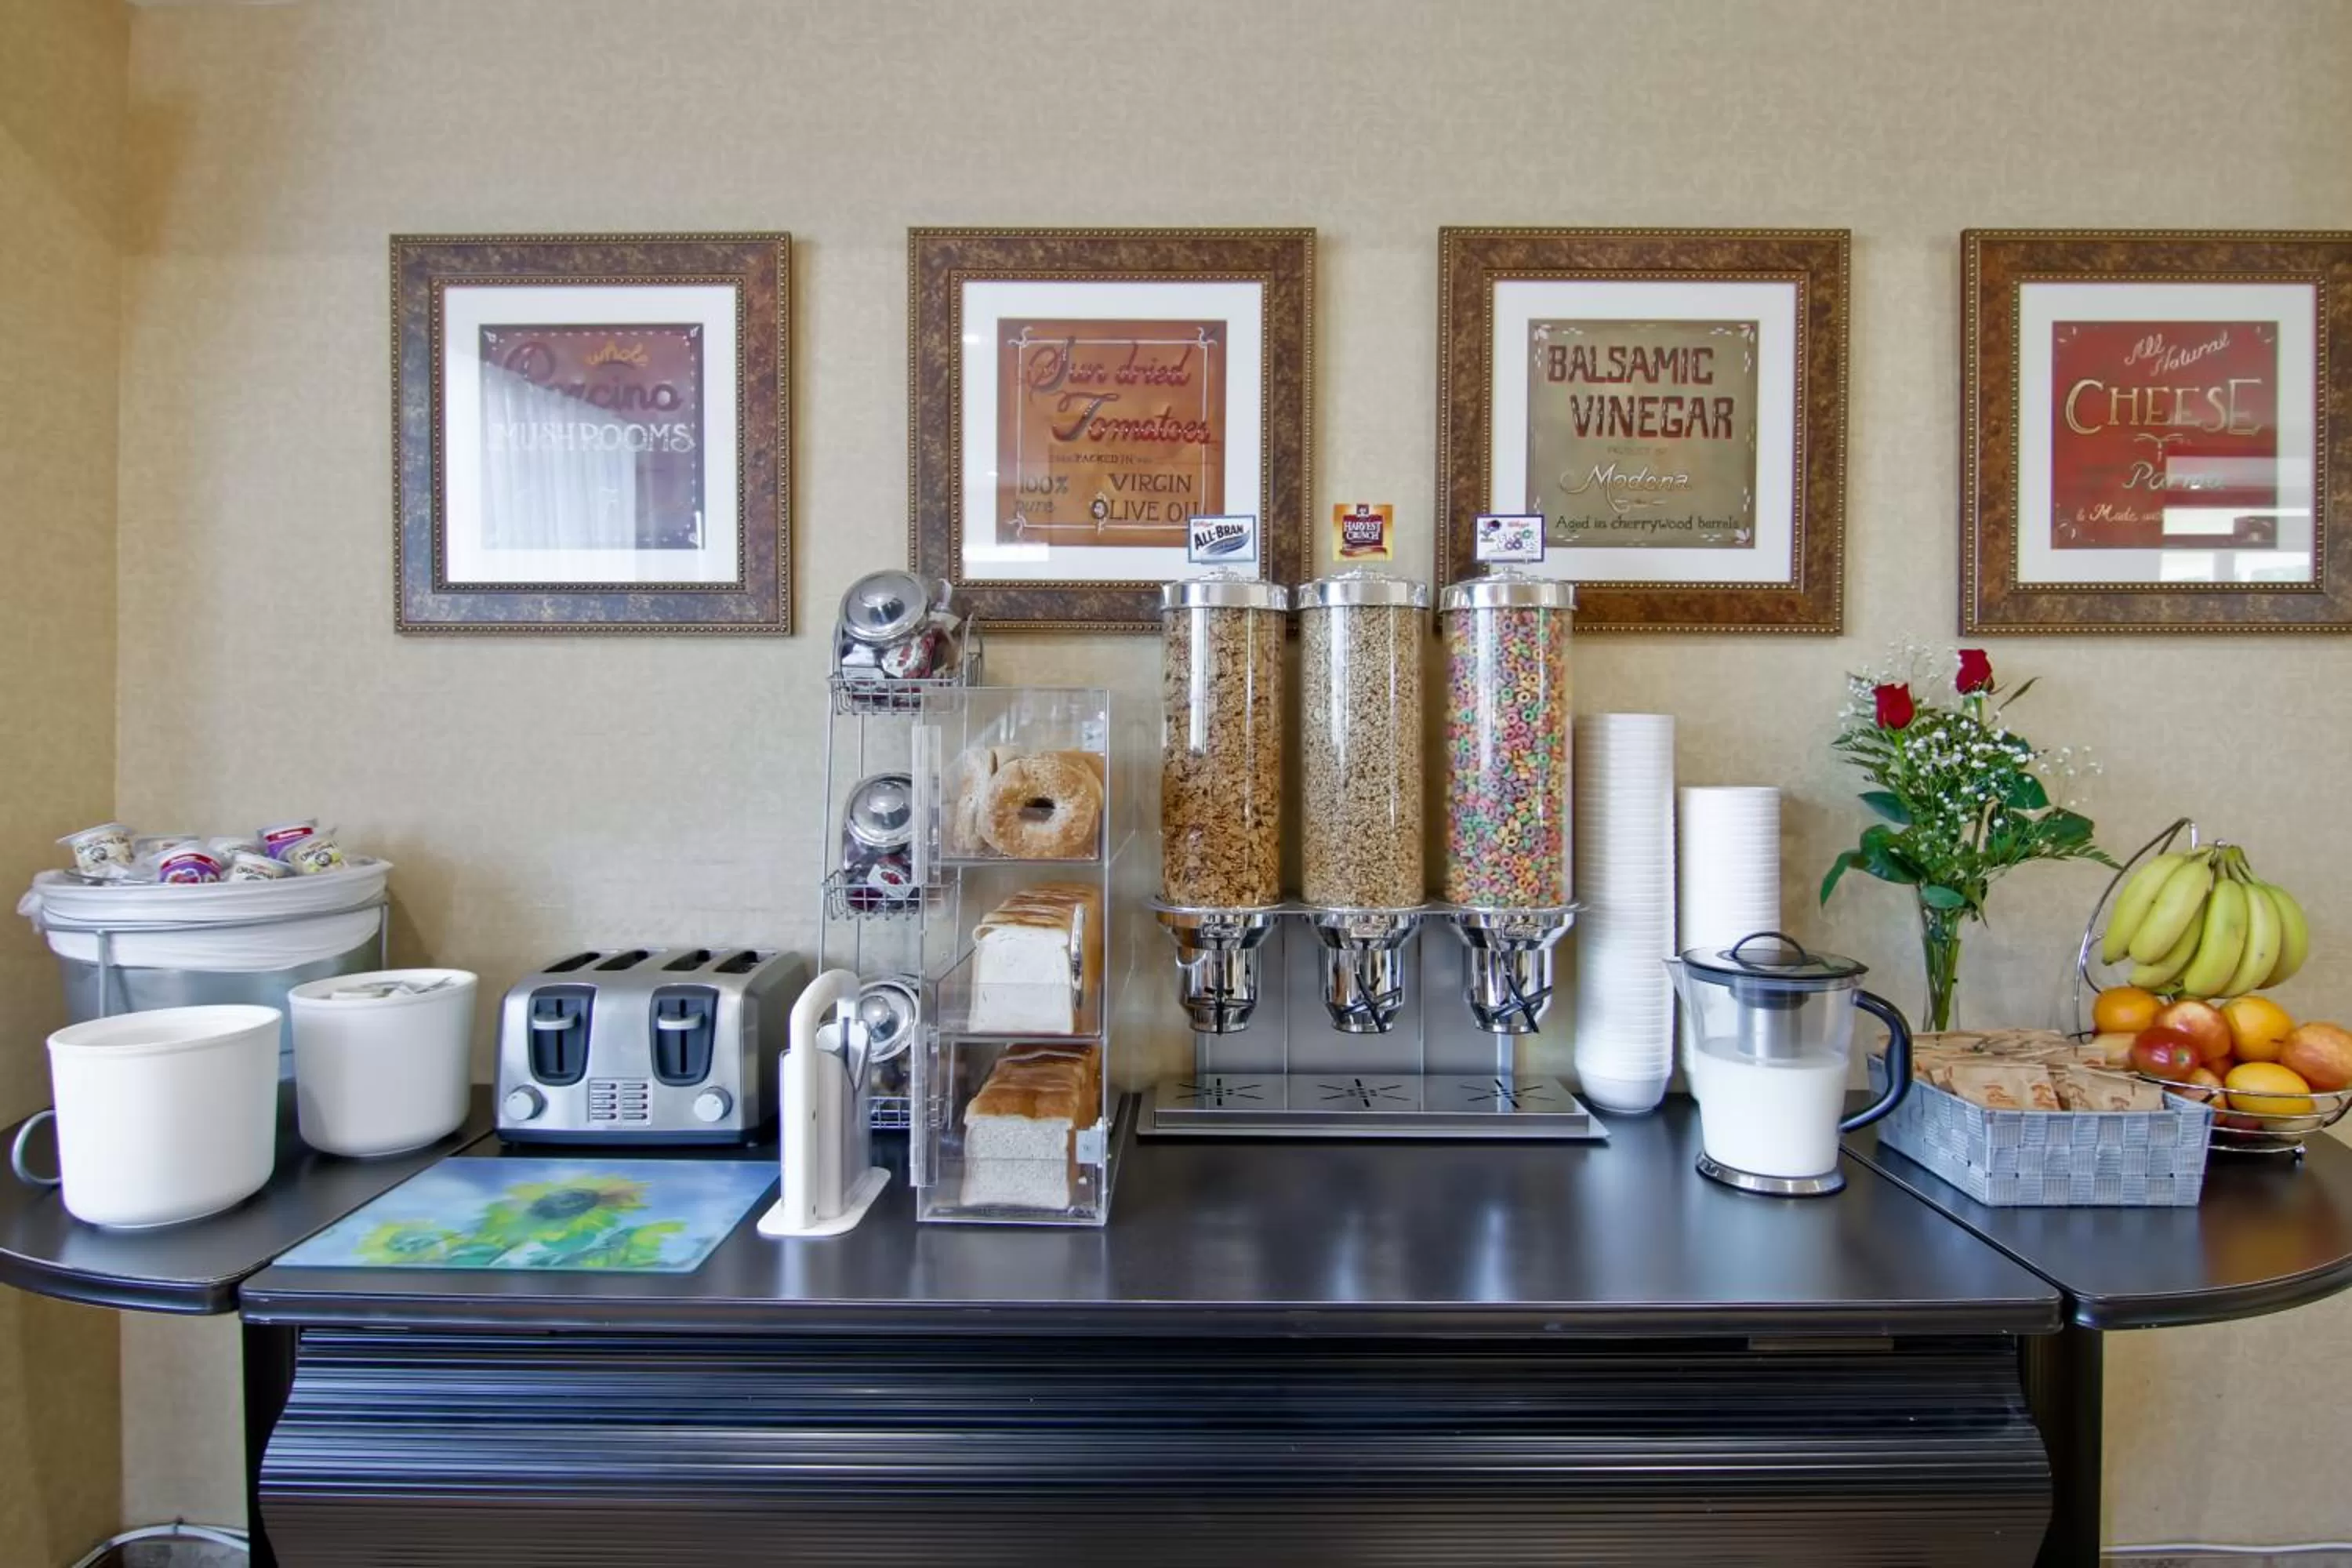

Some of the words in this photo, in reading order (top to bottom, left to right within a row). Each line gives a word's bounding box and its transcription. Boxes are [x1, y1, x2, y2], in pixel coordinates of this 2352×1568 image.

[1027, 336, 1108, 395] Sun
[1115, 342, 1192, 387] dried
[1548, 345, 1715, 385] BALSAMIC
[2124, 332, 2165, 366] All
[2150, 329, 2230, 376] Natural
[502, 342, 685, 411] Prcino
[1051, 391, 1214, 445] Tomatoes
[1570, 395, 1735, 439] VINEGAR
[2065, 378, 2264, 436] CHEESE
[486, 423, 696, 453] MUSHROOMS
[1020, 476, 1069, 495] 100%
[1107, 473, 1192, 494] VIRGIN
[1559, 462, 1693, 514] Modena
[1091, 499, 1161, 522] OLIVE
[1555, 515, 1590, 533] Aged
[1594, 517, 1607, 528] in
[1610, 514, 1693, 533] cherrywood
[1697, 514, 1739, 529] barrels
[1194, 524, 1245, 550] ALL-BRAN
